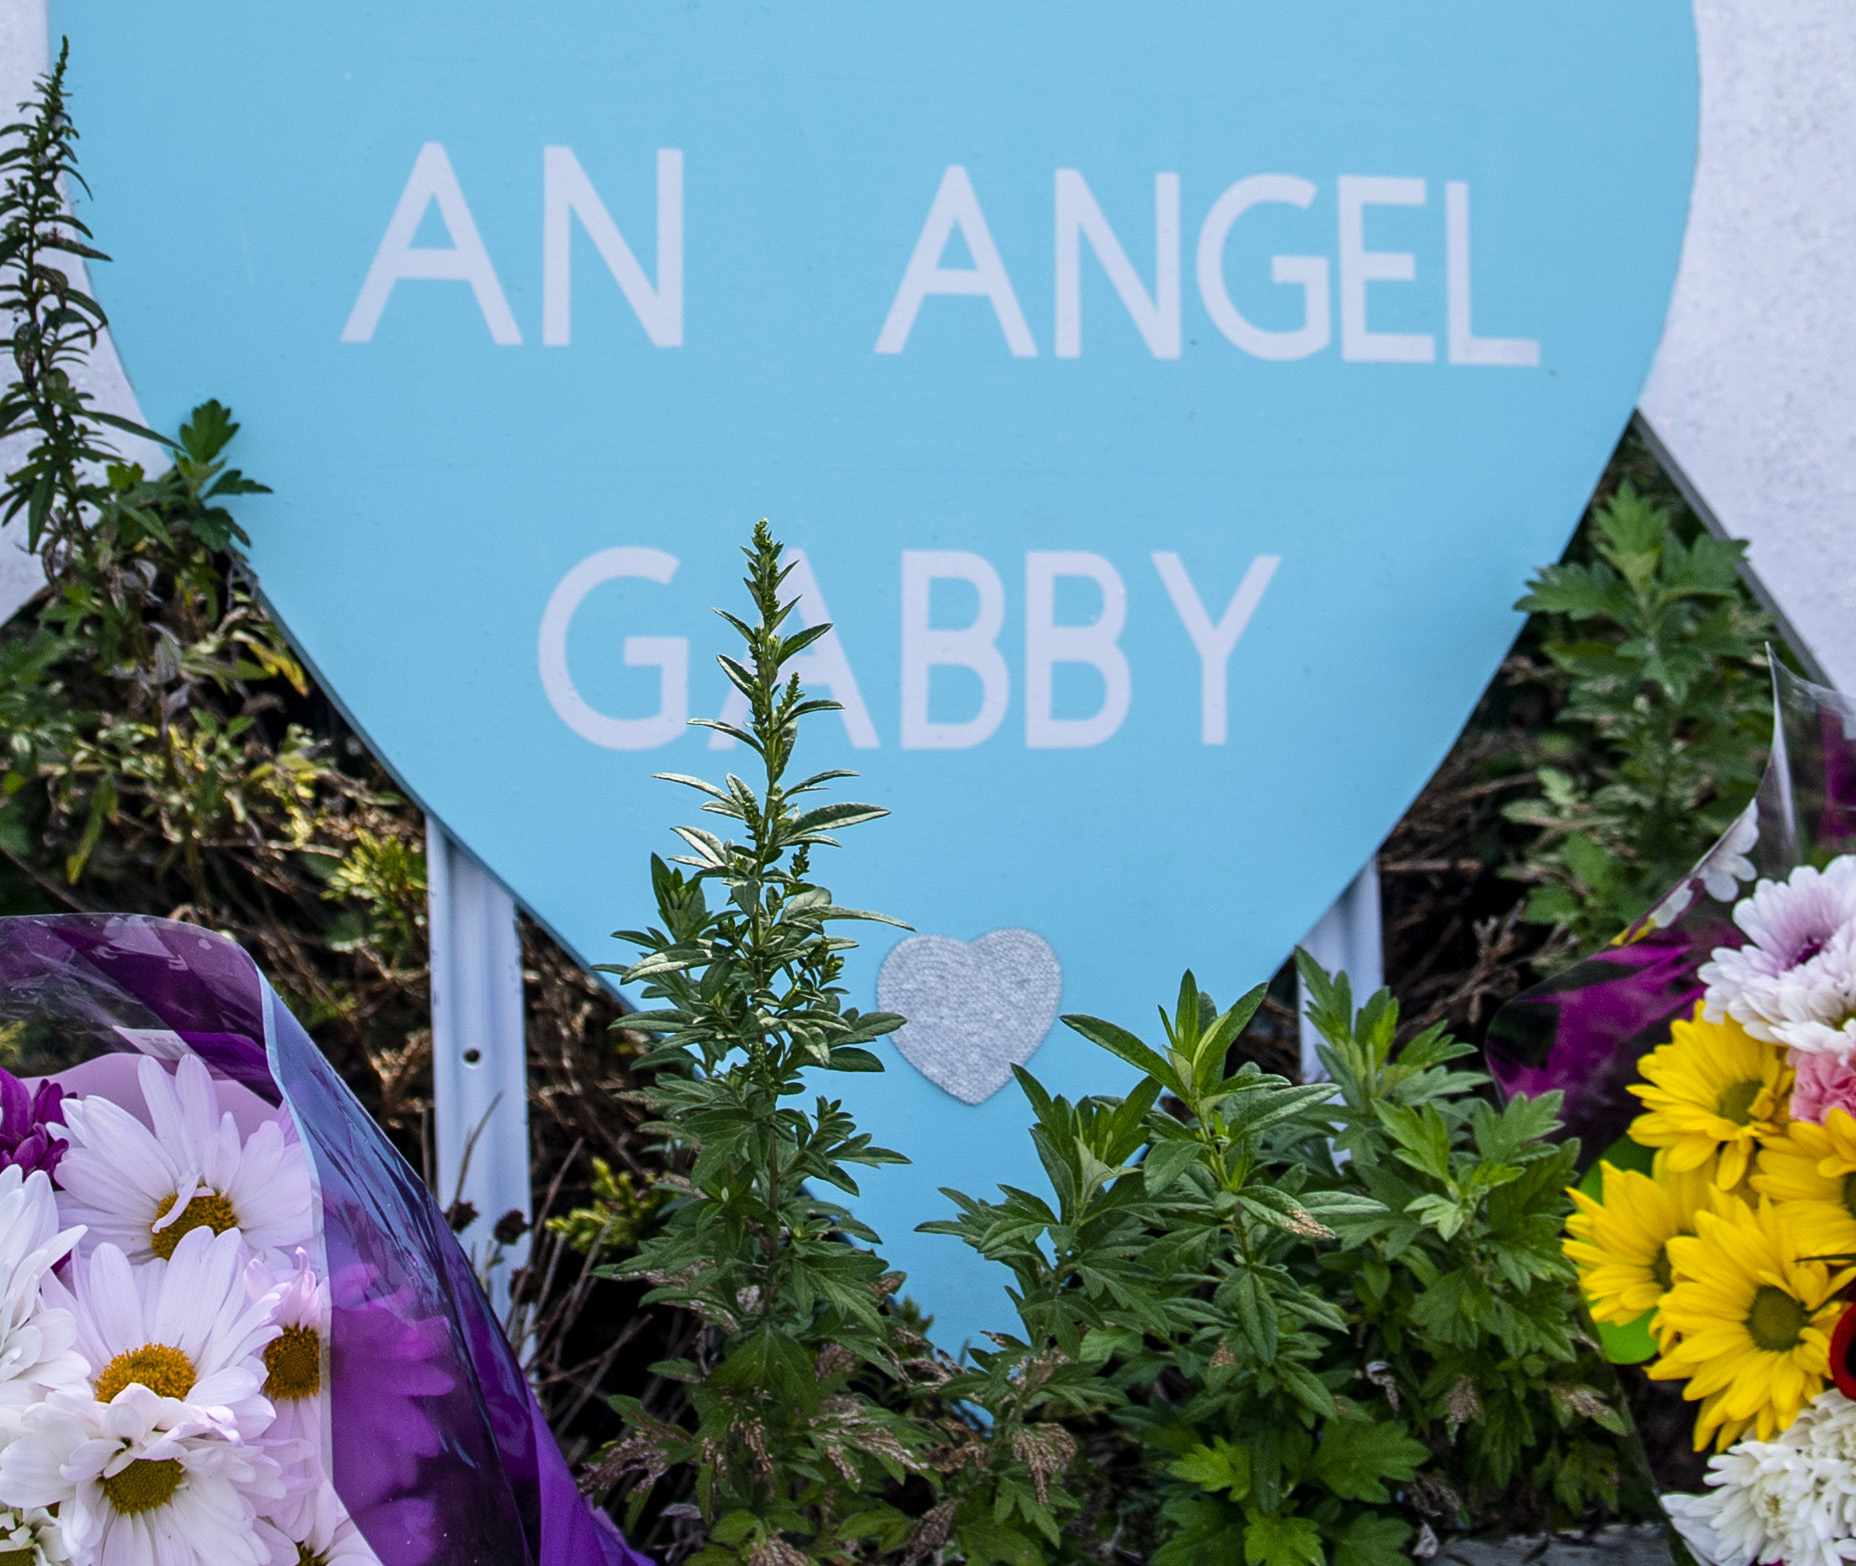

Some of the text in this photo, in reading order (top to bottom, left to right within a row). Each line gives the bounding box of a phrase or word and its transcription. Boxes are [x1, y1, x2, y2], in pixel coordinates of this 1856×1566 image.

[340, 141, 1541, 367] AN ANGEL
[537, 545, 1283, 752] GABBY
